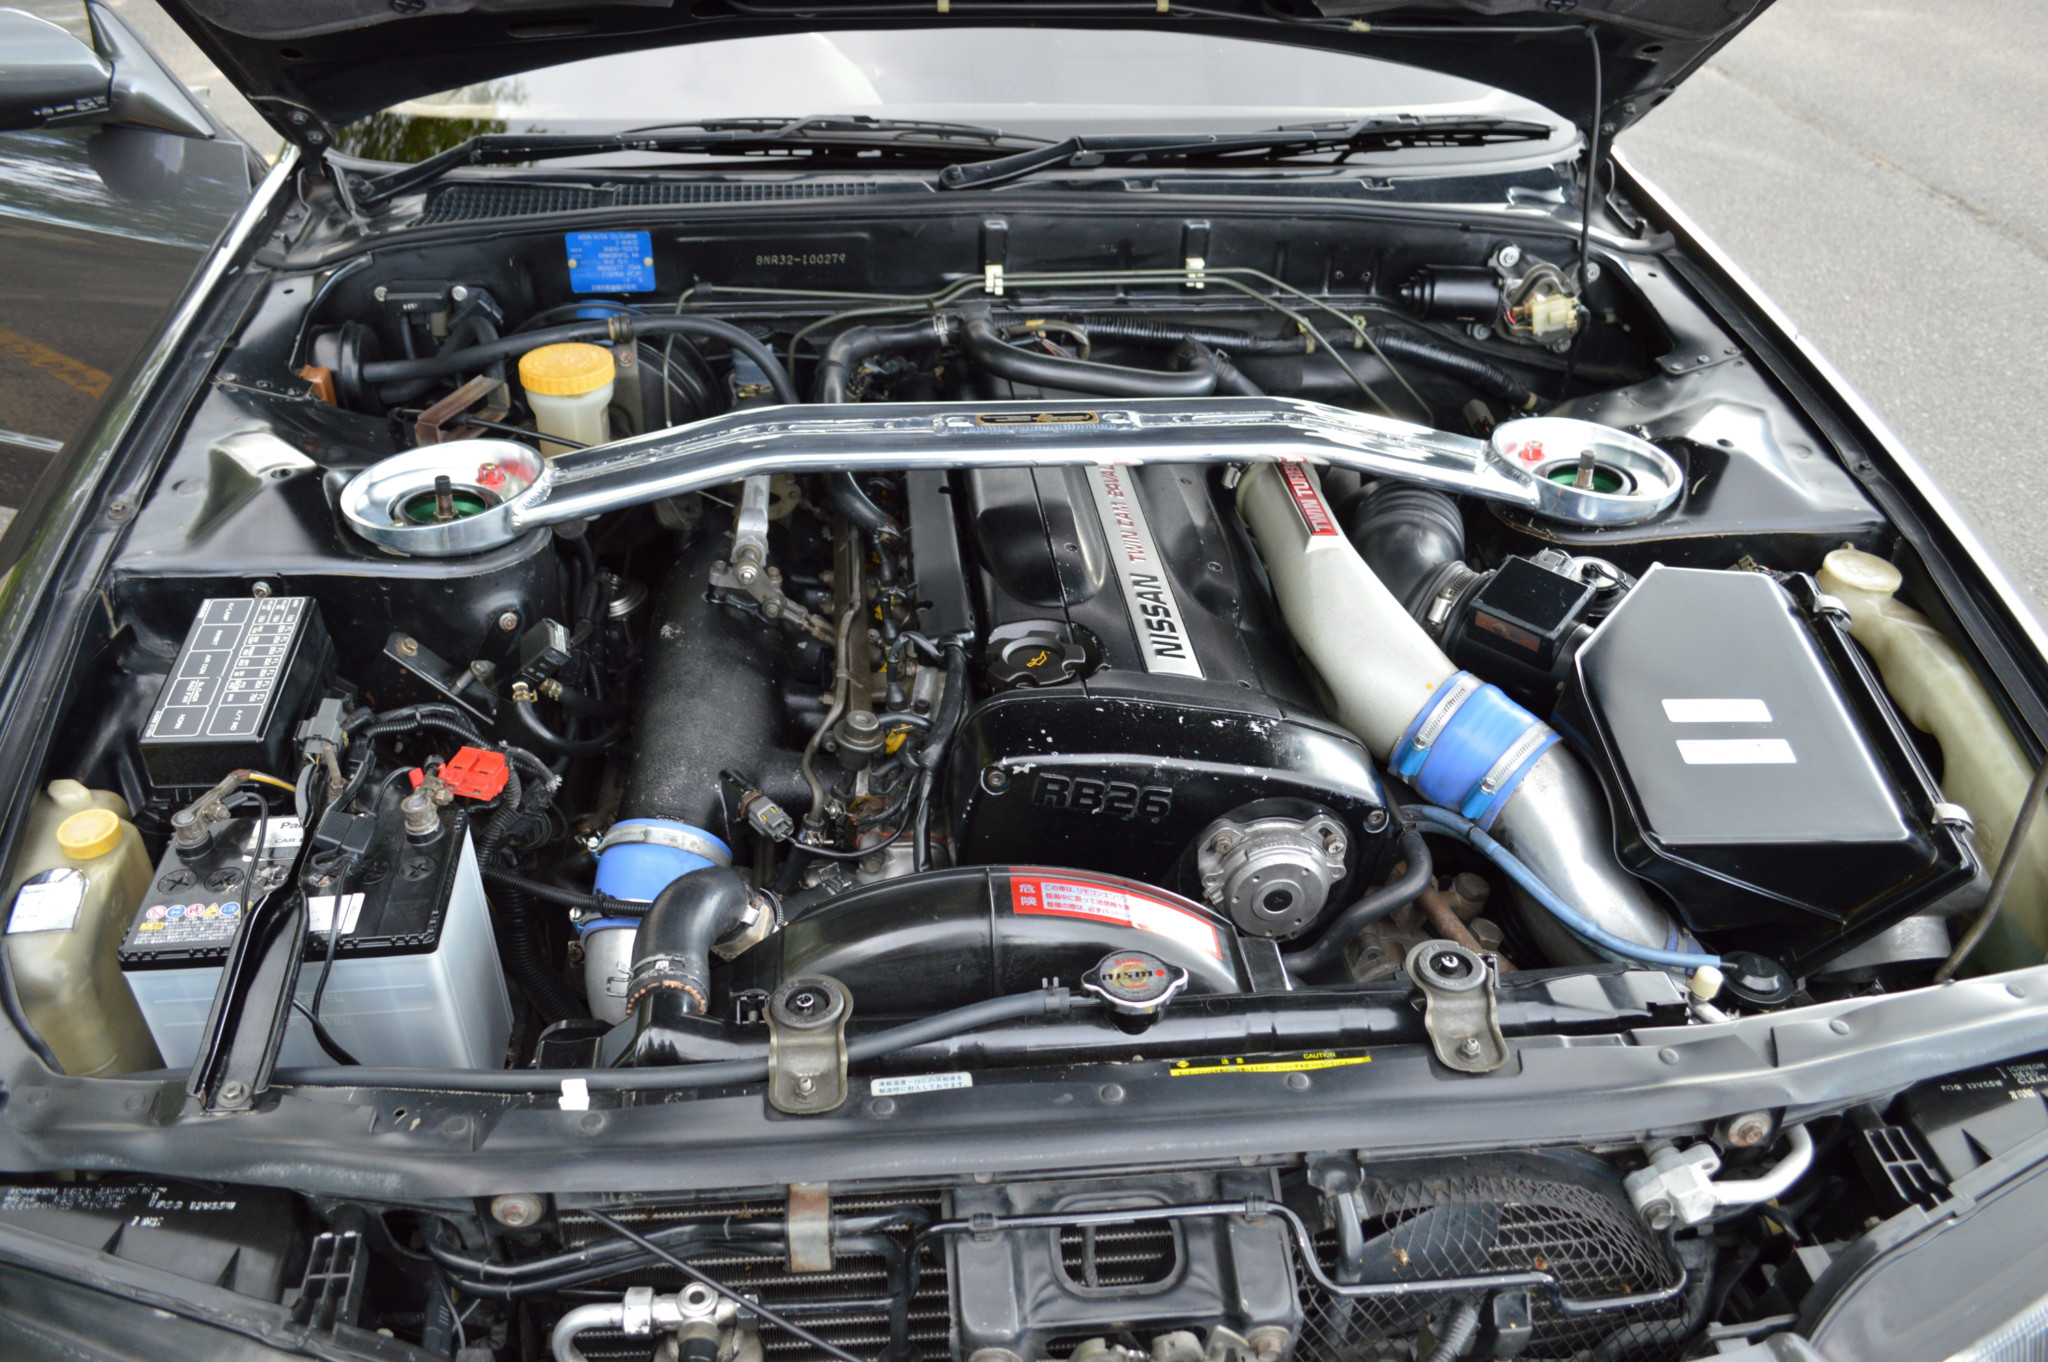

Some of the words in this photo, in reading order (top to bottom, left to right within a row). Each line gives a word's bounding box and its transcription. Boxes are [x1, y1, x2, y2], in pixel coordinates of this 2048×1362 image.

[756, 253, 846, 265] BNR32-100279
[1111, 502, 1135, 528] CAM
[1300, 499, 1333, 532] TWIN
[1121, 530, 1147, 563] TWIN
[1129, 573, 1186, 660] NISSAN
[1032, 772, 1173, 819] RB26
[1019, 883, 1038, 906] 危険
[1303, 1051, 1336, 1060] CAUTION
